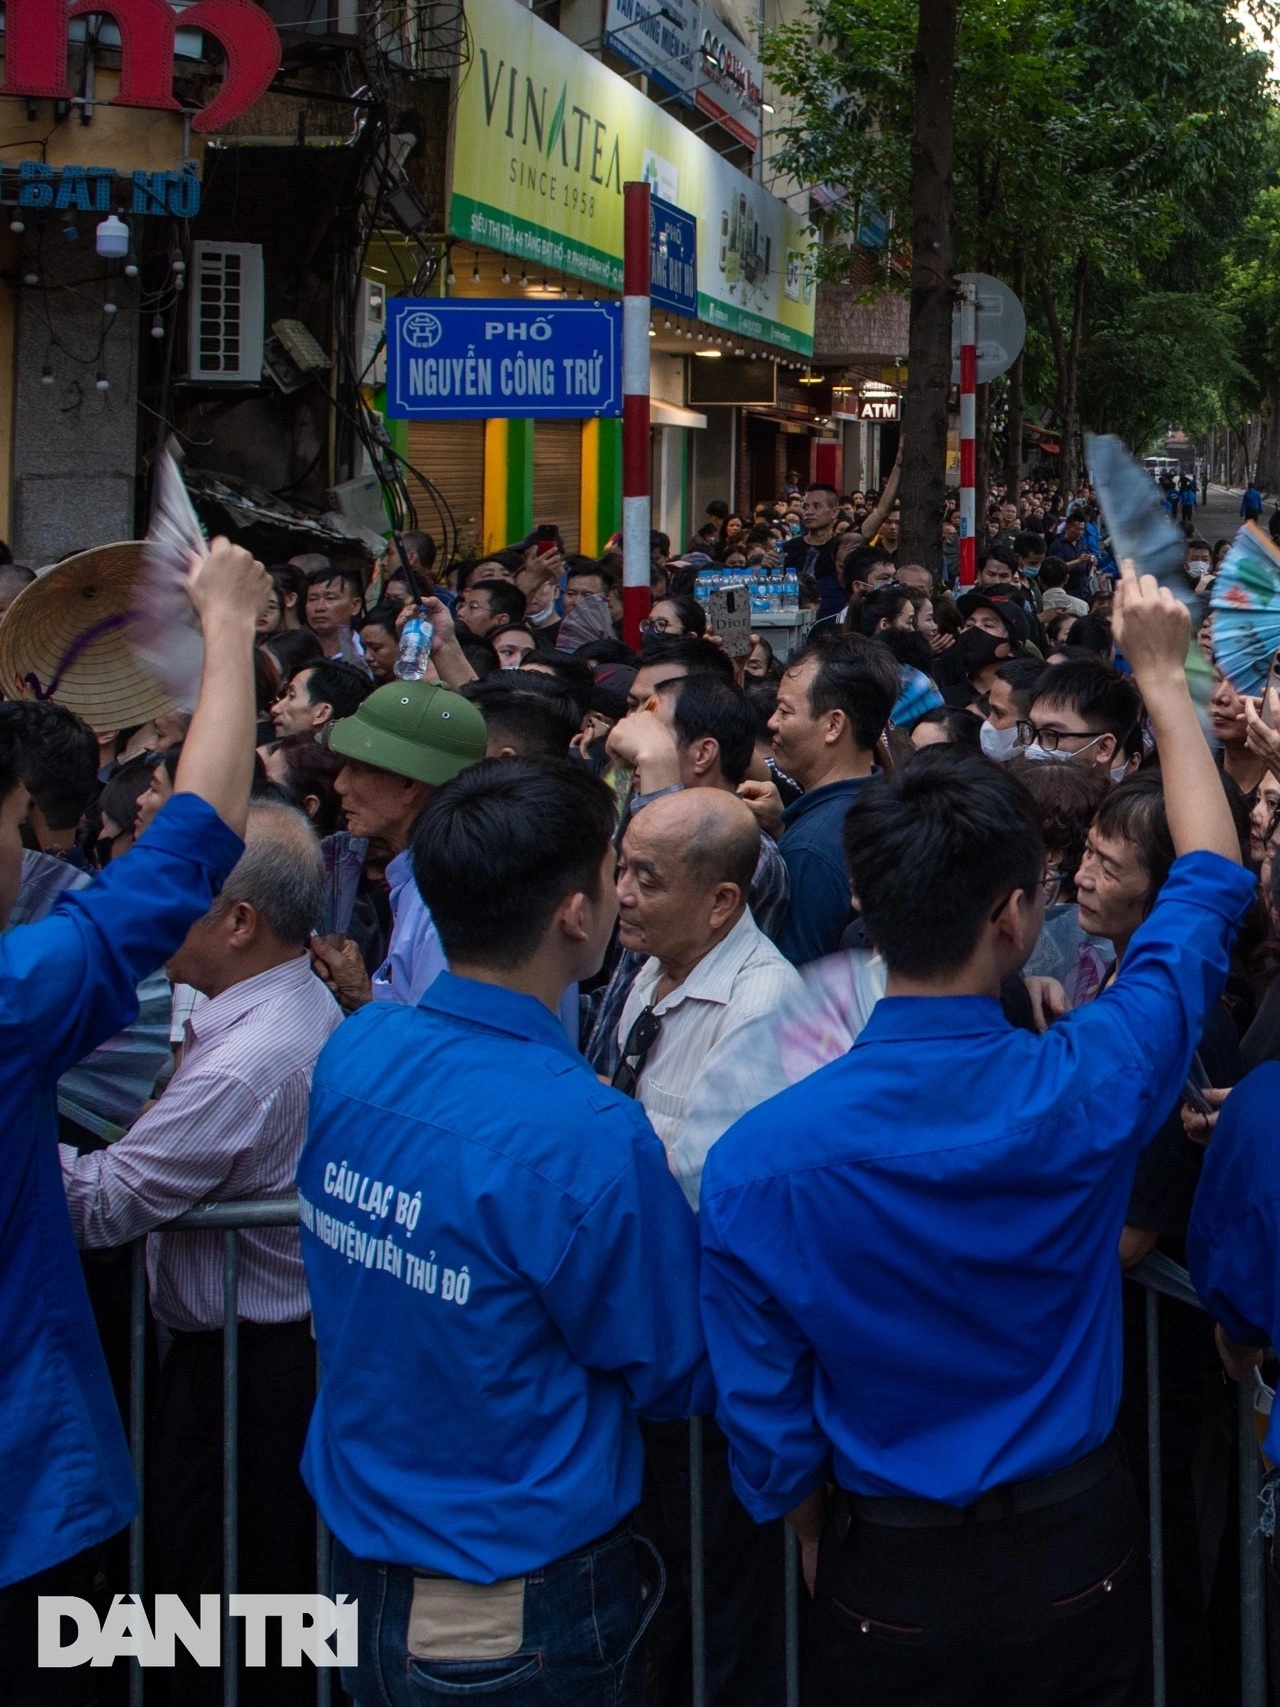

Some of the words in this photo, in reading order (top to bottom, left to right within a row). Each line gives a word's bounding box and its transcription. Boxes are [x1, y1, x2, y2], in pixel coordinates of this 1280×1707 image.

[480, 47, 622, 196] VINATEA
[510, 157, 557, 201] SINCE
[564, 184, 595, 218] 1958
[665, 221, 681, 245] PHỐ
[485, 314, 555, 341] PHỐ
[409, 344, 492, 396] NGUYỄN
[500, 350, 555, 396] CÔNG
[563, 349, 604, 396] TRỨ
[861, 403, 897, 418] ATM
[716, 619, 747, 630] Dior
[324, 1160, 360, 1204] CÂU
[357, 1177, 394, 1221] LẠC
[395, 1191, 422, 1238] BỘ
[316, 1207, 368, 1264] NGUYỆN
[365, 1234, 403, 1279] VIÊN
[405, 1250, 438, 1294] THỦ
[441, 1265, 471, 1306] ĐÔ
